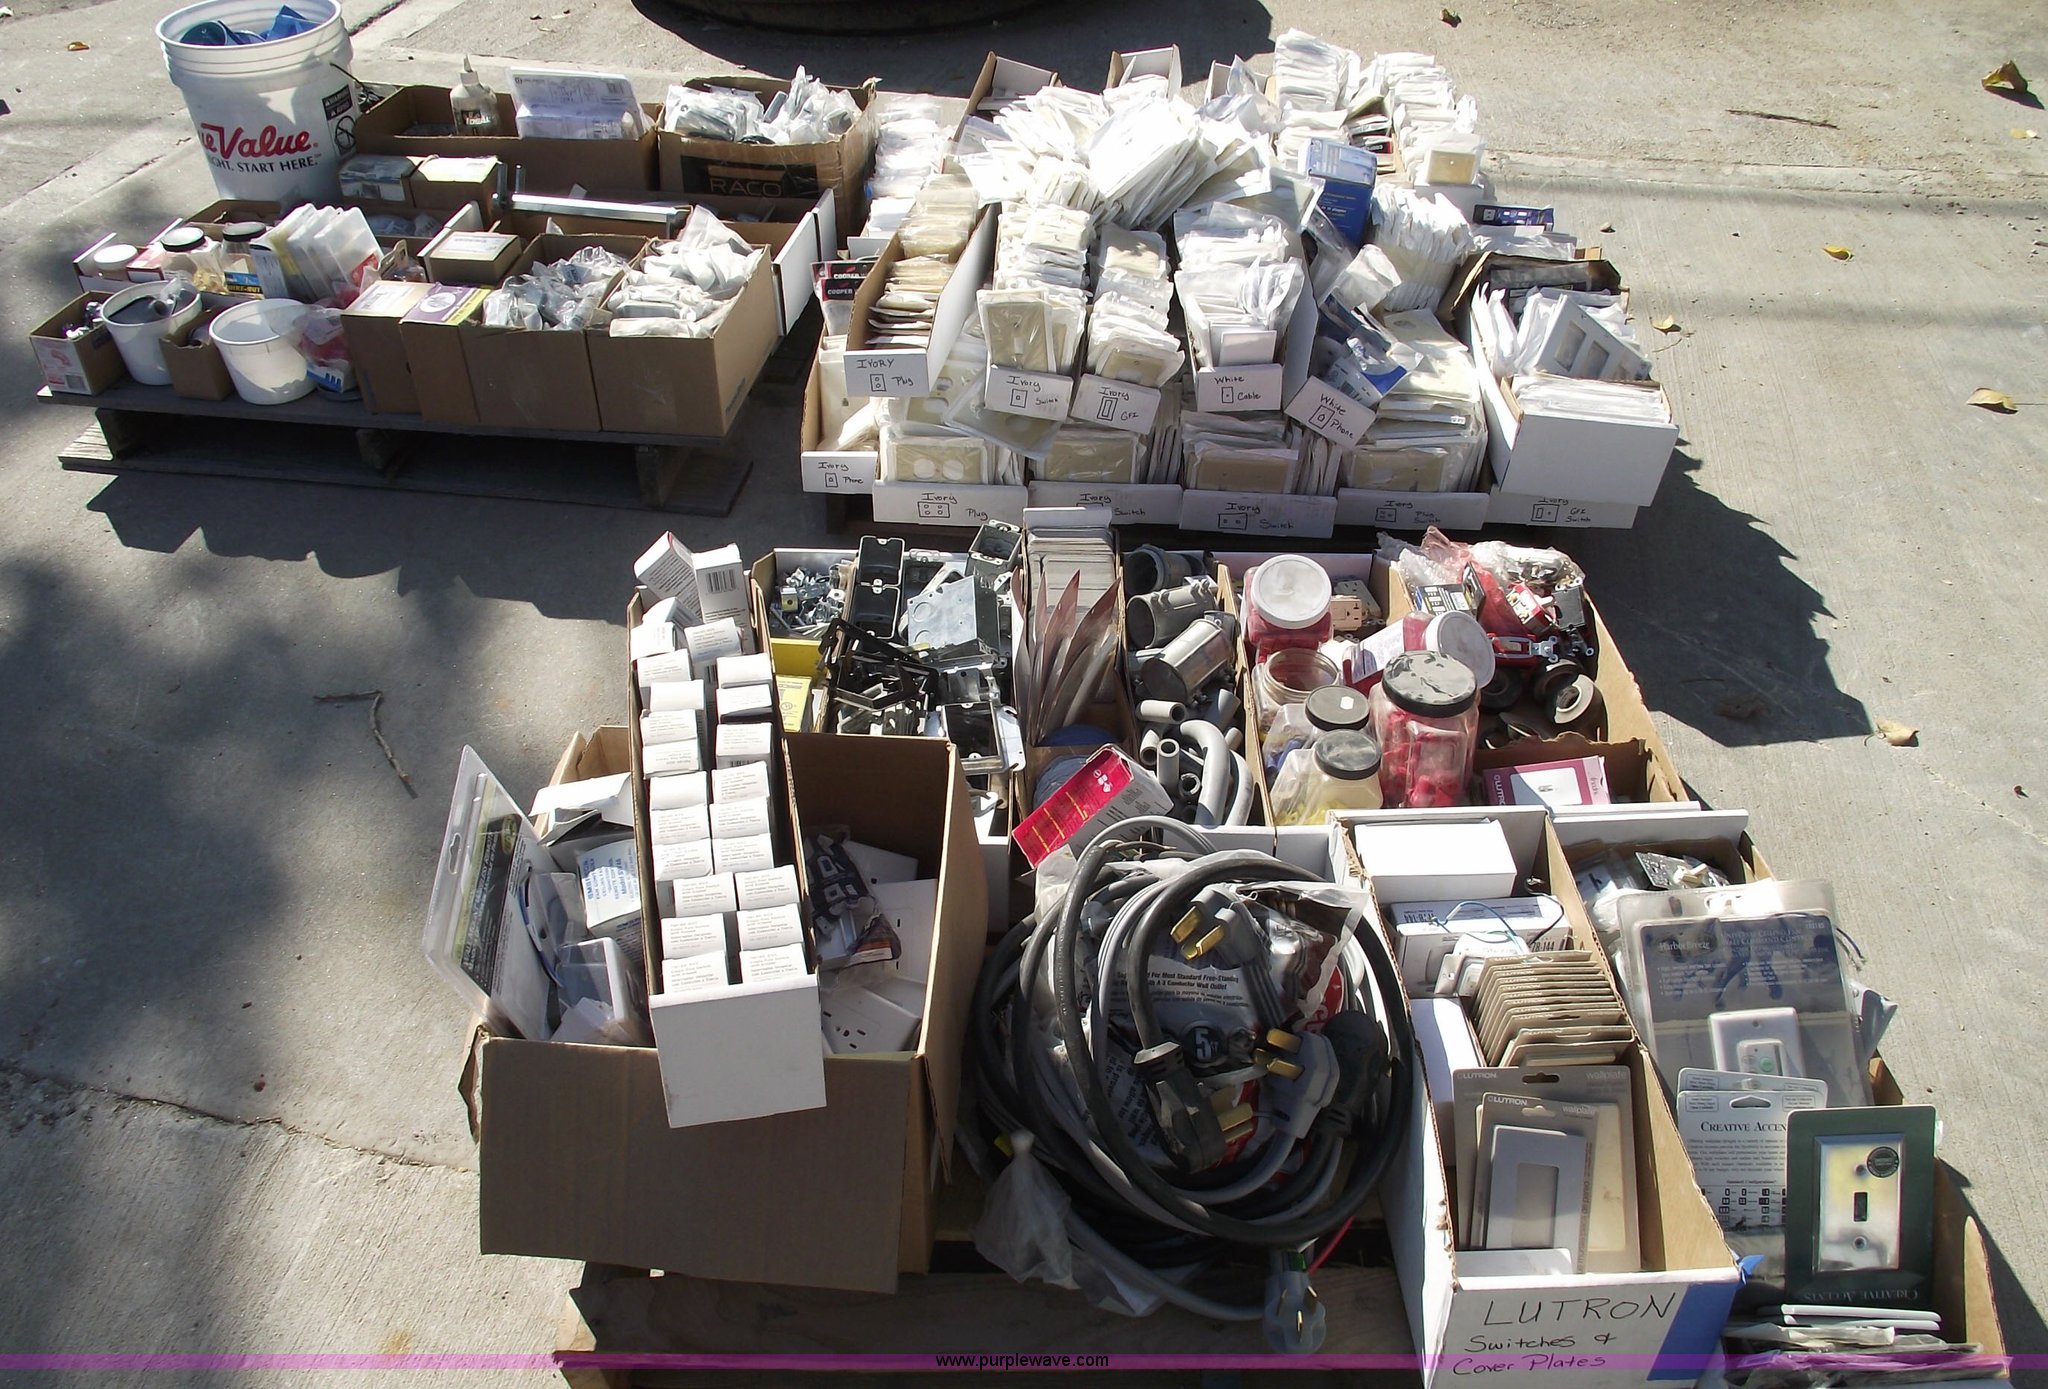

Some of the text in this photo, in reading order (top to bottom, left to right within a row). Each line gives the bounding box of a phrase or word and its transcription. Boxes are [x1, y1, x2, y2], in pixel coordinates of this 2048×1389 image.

[201, 122, 312, 160] Value
[212, 155, 318, 173] GHT. START HERE.
[709, 178, 782, 198] RACO
[827, 287, 853, 295] COOPER
[857, 358, 895, 369] IVORY
[892, 376, 914, 386] Plug
[1006, 375, 1041, 392] Ivory
[1214, 375, 1245, 385] White
[1098, 386, 1130, 400] Ivory
[1237, 391, 1261, 401] Cable
[1320, 393, 1347, 416] White
[1120, 411, 1140, 421] GFI
[1330, 419, 1354, 439] Phone
[818, 461, 849, 472] Ivory
[921, 492, 958, 504] Ivory
[1080, 493, 1112, 503] Ivory
[1224, 502, 1261, 514] Ivory
[1383, 500, 1413, 509] Ivory
[966, 508, 989, 521] Plug
[1114, 508, 1146, 516] Switch
[1259, 518, 1294, 529] Switch
[1161, 972, 1176, 980] Most
[1177, 973, 1202, 981] Standard
[1167, 980, 1195, 988] Conductor
[1196, 981, 1209, 989] Wall
[1194, 1027, 1213, 1062] 5
[1585, 1071, 1627, 1081] wallplate
[1493, 1095, 1528, 1106] LUTRON
[1562, 1105, 1597, 1116] wallplate
[1700, 1121, 1787, 1132] CREATIVE ACCEN
[1483, 1292, 1676, 1326] LUTRON
[1464, 1335, 1576, 1353] Switches
[1452, 1352, 1606, 1376] Cover Plates
